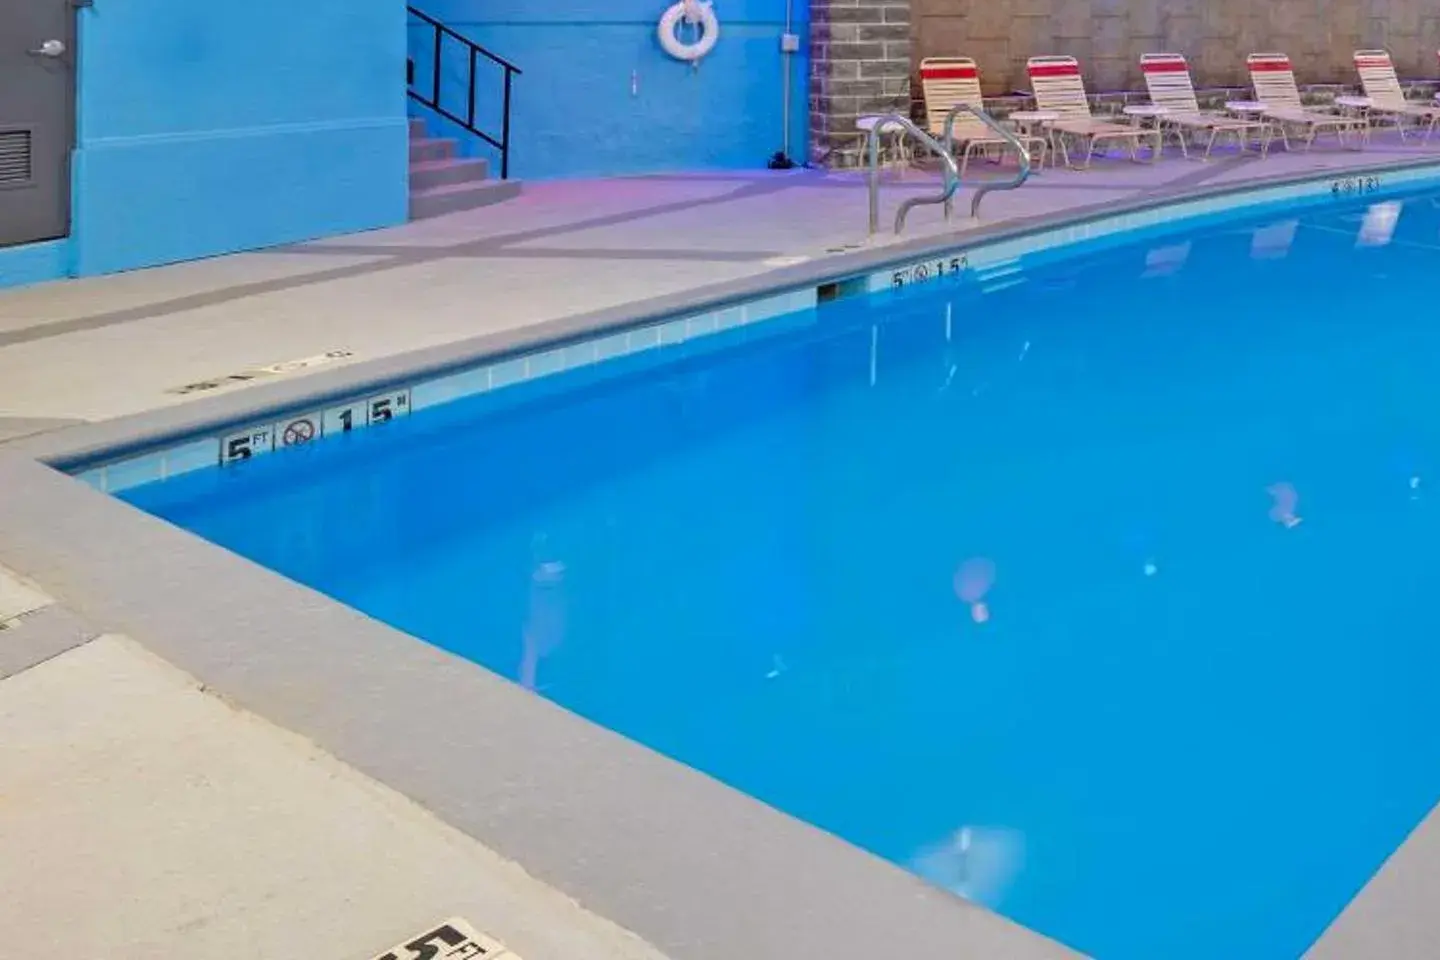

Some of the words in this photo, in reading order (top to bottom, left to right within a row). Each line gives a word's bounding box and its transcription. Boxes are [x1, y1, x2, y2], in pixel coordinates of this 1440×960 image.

[228, 436, 251, 459] 5
[253, 431, 268, 445] FT
[446, 942, 487, 960] FT
